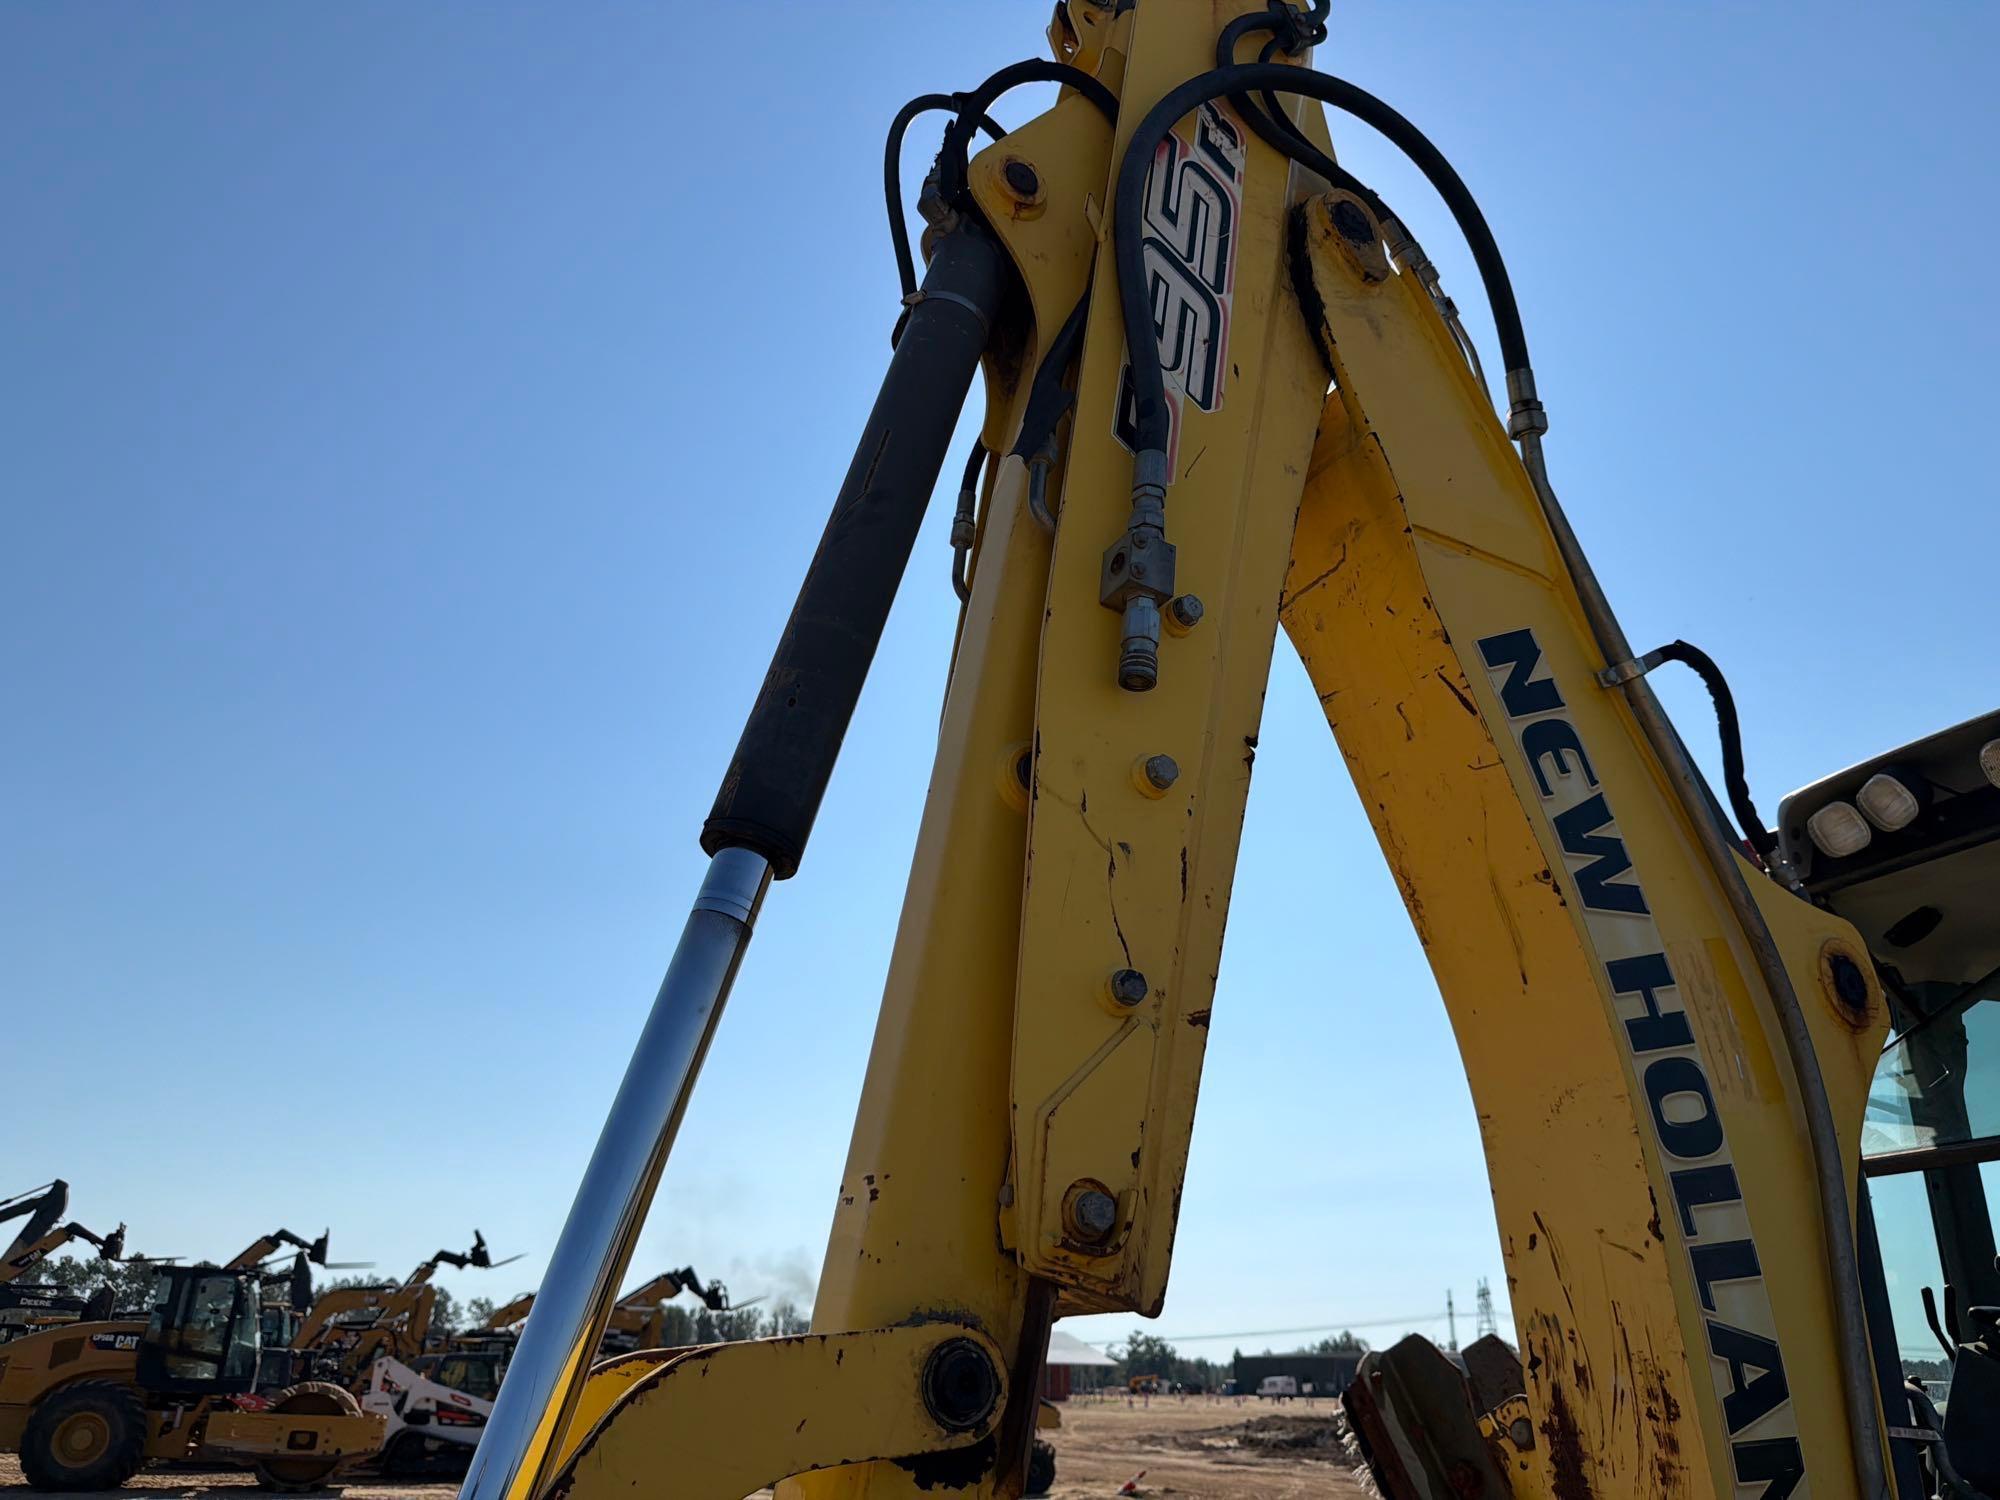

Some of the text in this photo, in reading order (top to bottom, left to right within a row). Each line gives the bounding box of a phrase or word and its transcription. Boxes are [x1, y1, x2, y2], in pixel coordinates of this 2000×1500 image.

[1476, 628, 1652, 915] NEW
[20, 1297, 52, 1307] DEERE
[115, 1334, 140, 1350] CAT
